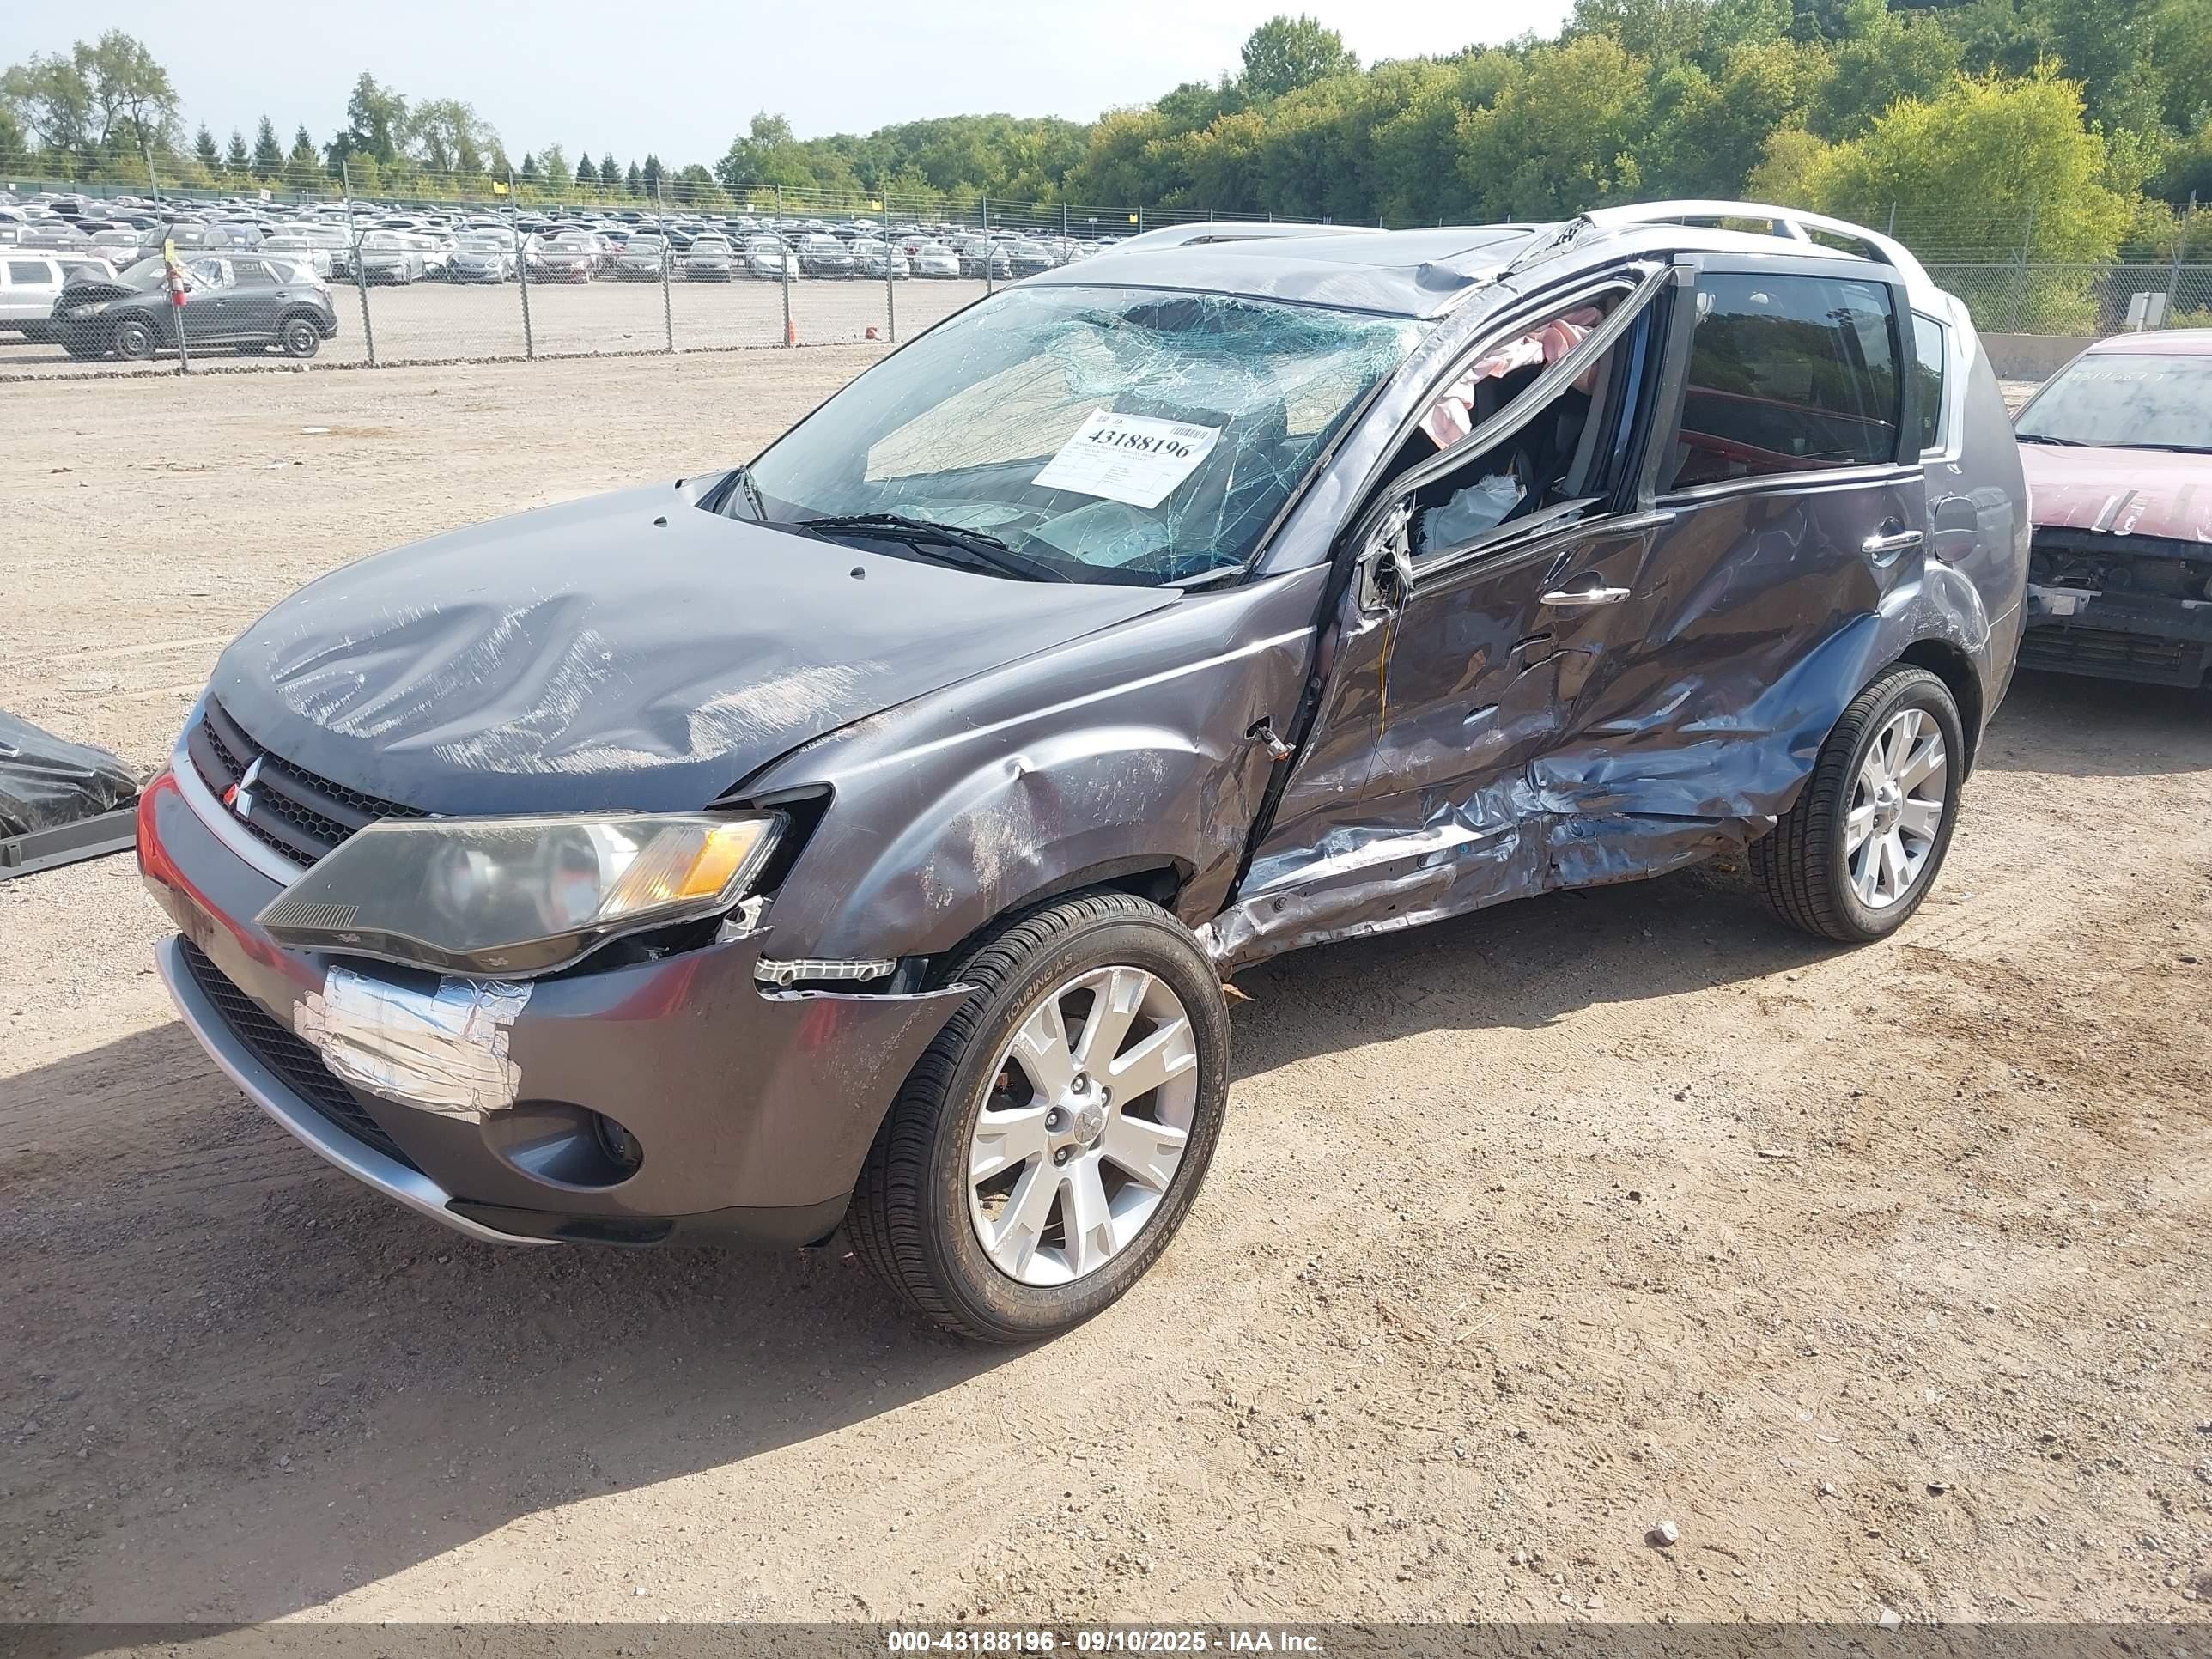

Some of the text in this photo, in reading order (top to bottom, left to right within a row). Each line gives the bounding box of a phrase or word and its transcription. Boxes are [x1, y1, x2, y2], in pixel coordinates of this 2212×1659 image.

[1088, 428, 1195, 459] 43188196
[1003, 952, 1073, 1024] TOURING A/S
[1156, 1200, 1188, 1250] 225/55
[1133, 1249, 1154, 1276] R18
